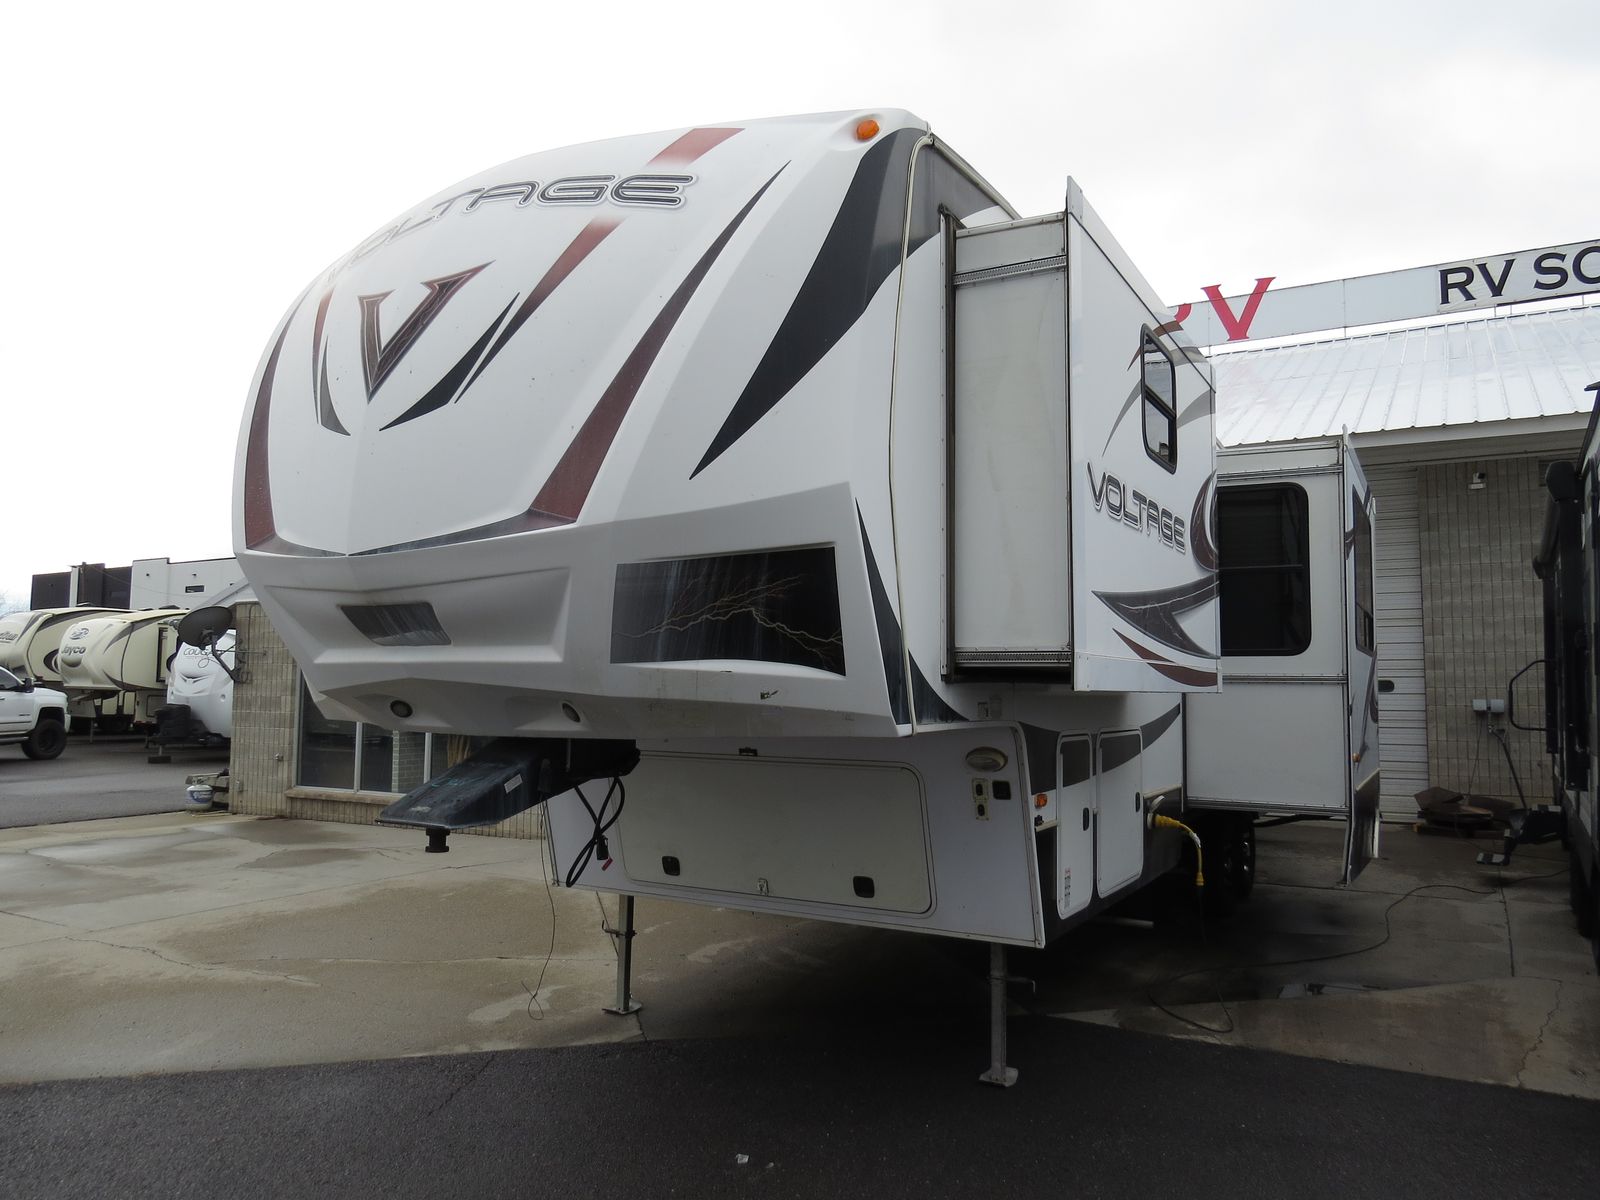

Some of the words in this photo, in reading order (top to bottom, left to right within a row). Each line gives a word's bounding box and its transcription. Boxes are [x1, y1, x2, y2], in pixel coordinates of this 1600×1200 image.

[1174, 276, 1276, 341] V
[1438, 258, 1516, 305] RV
[1086, 461, 1185, 554] VOLTAGE
